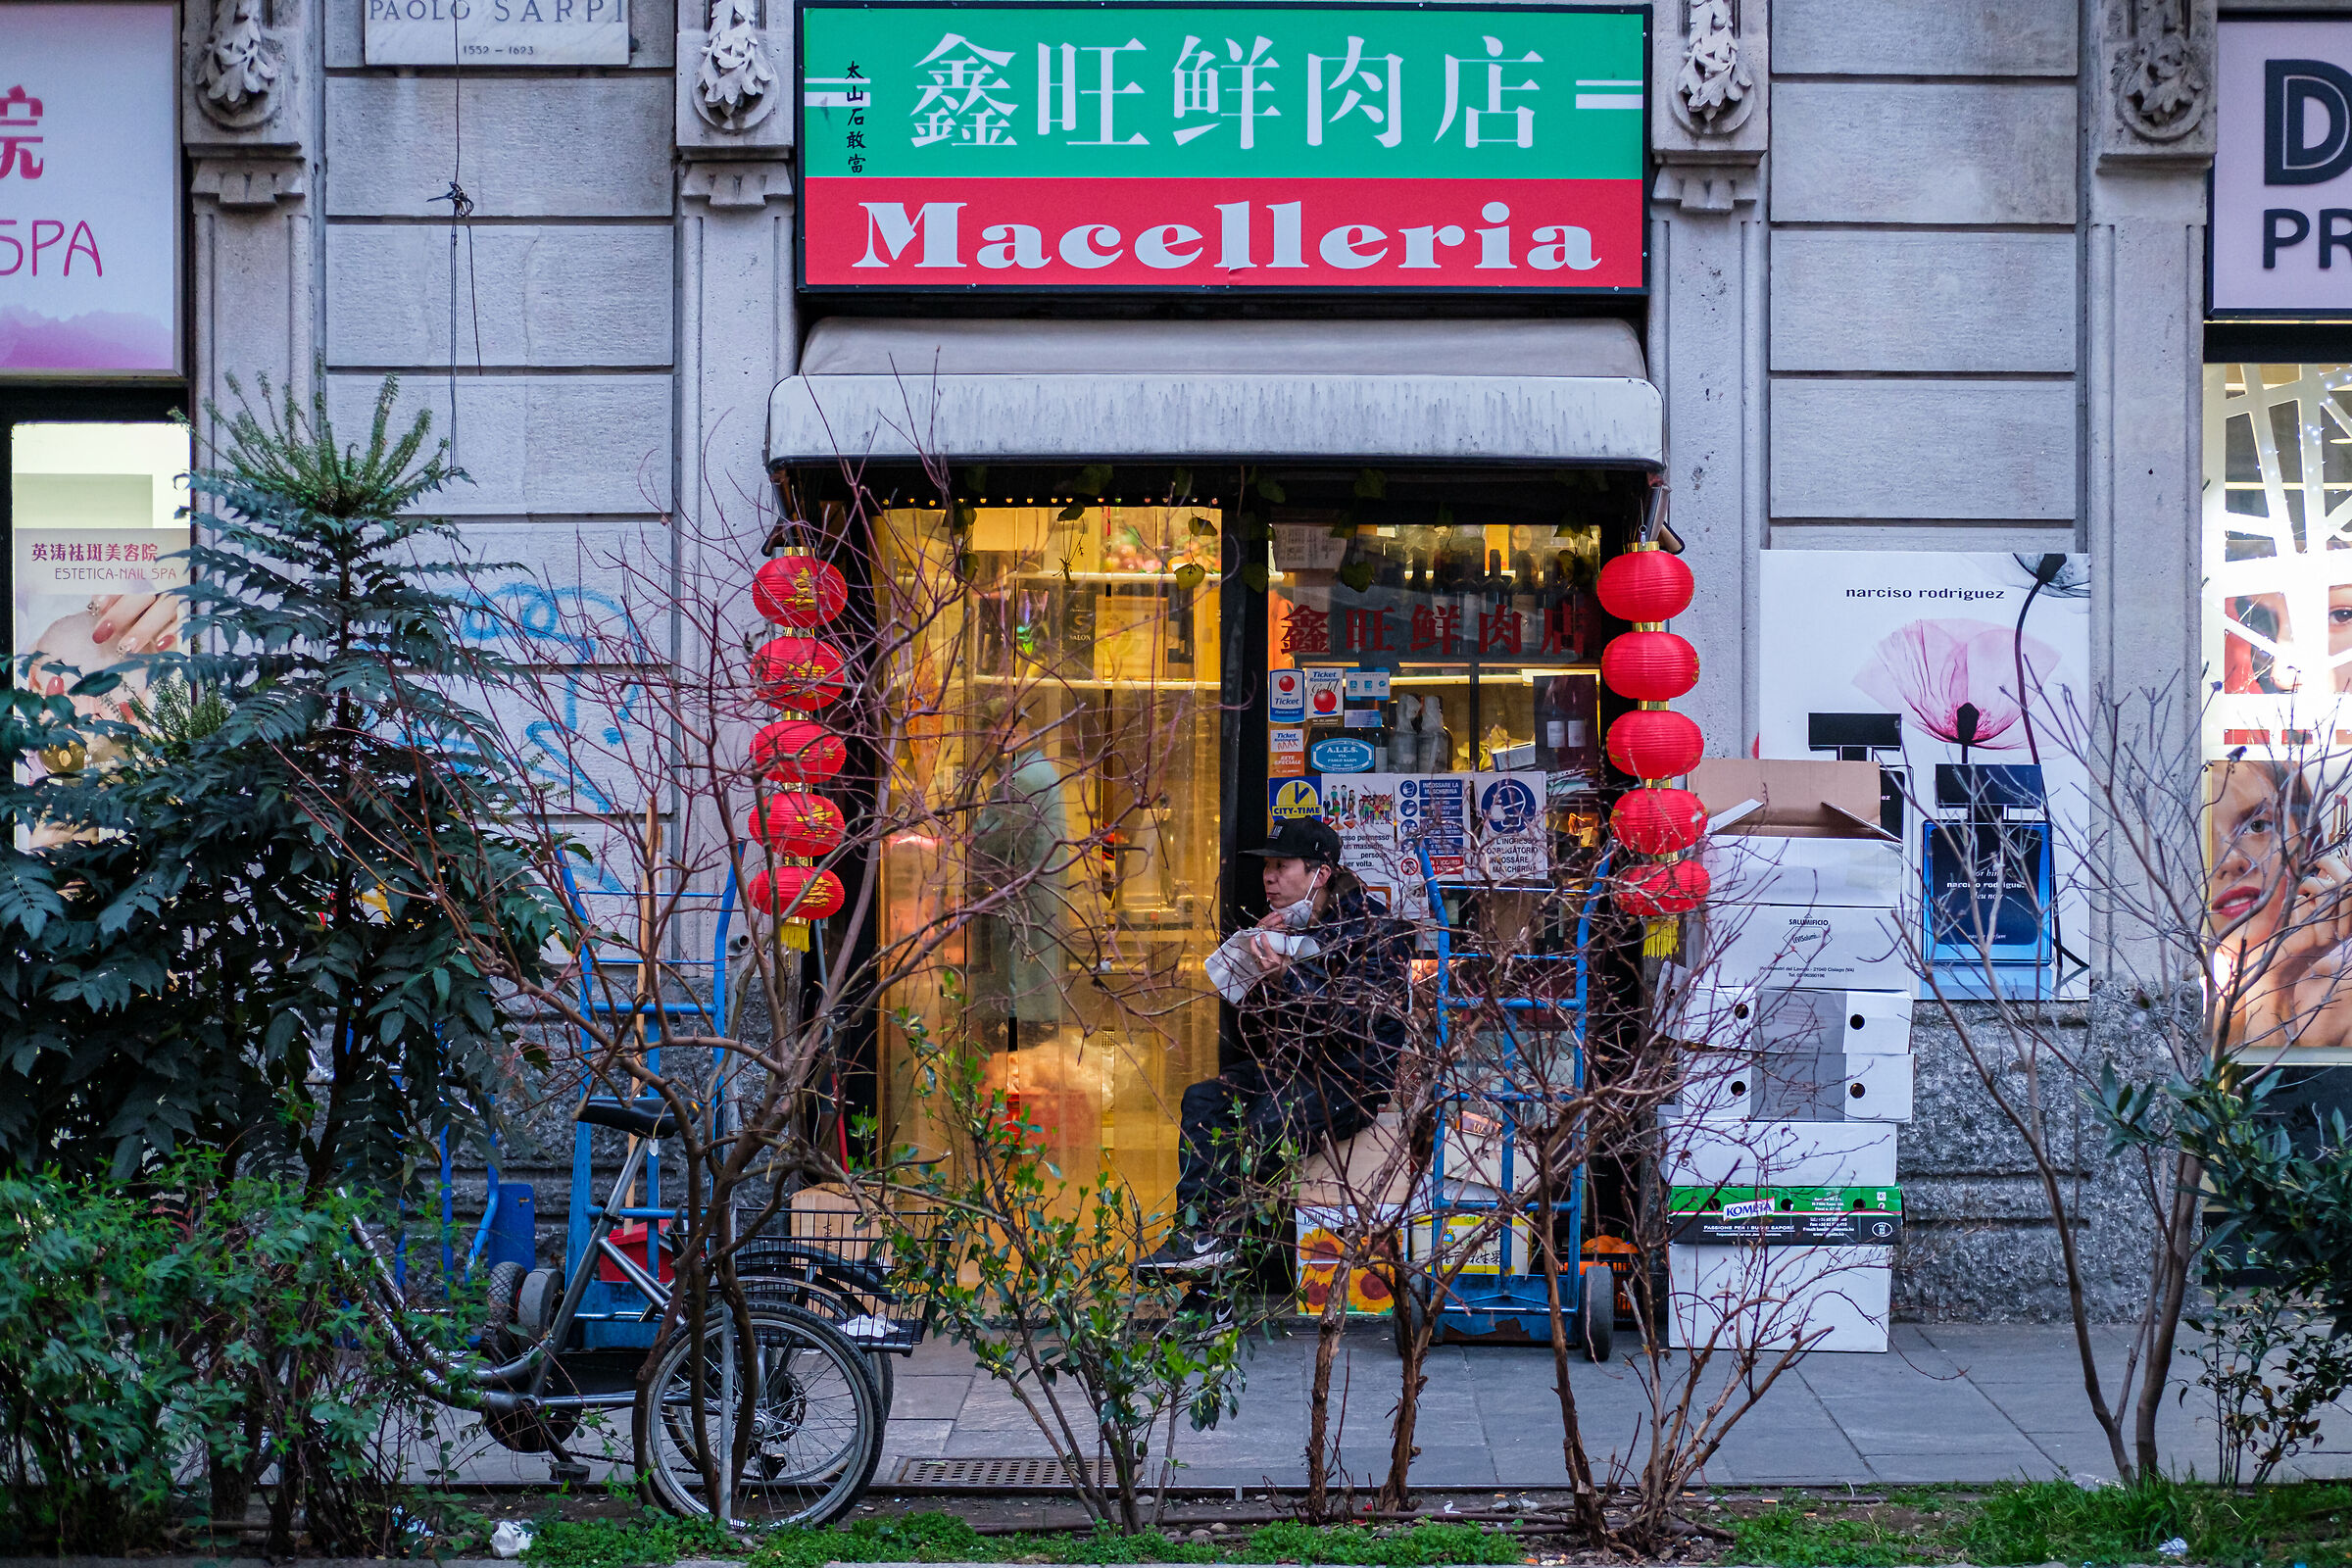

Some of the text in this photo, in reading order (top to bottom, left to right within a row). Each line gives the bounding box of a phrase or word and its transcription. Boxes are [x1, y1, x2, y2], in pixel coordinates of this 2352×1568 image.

[369, 0, 623, 23] PAOLO SARPI
[464, 45, 490, 55] 1552
[909, 33, 1544, 150] 鑫旺鲜肉店
[852, 200, 1602, 271] Macelleria
[0, 220, 103, 276] SPA
[55, 567, 176, 580] ESTETICA-NAIL SPA
[1845, 586, 2005, 601] narciso rodriguez
[1281, 604, 1585, 655] 鑫旺鲜肉店
[1274, 807, 1320, 815] CITY-TIME
